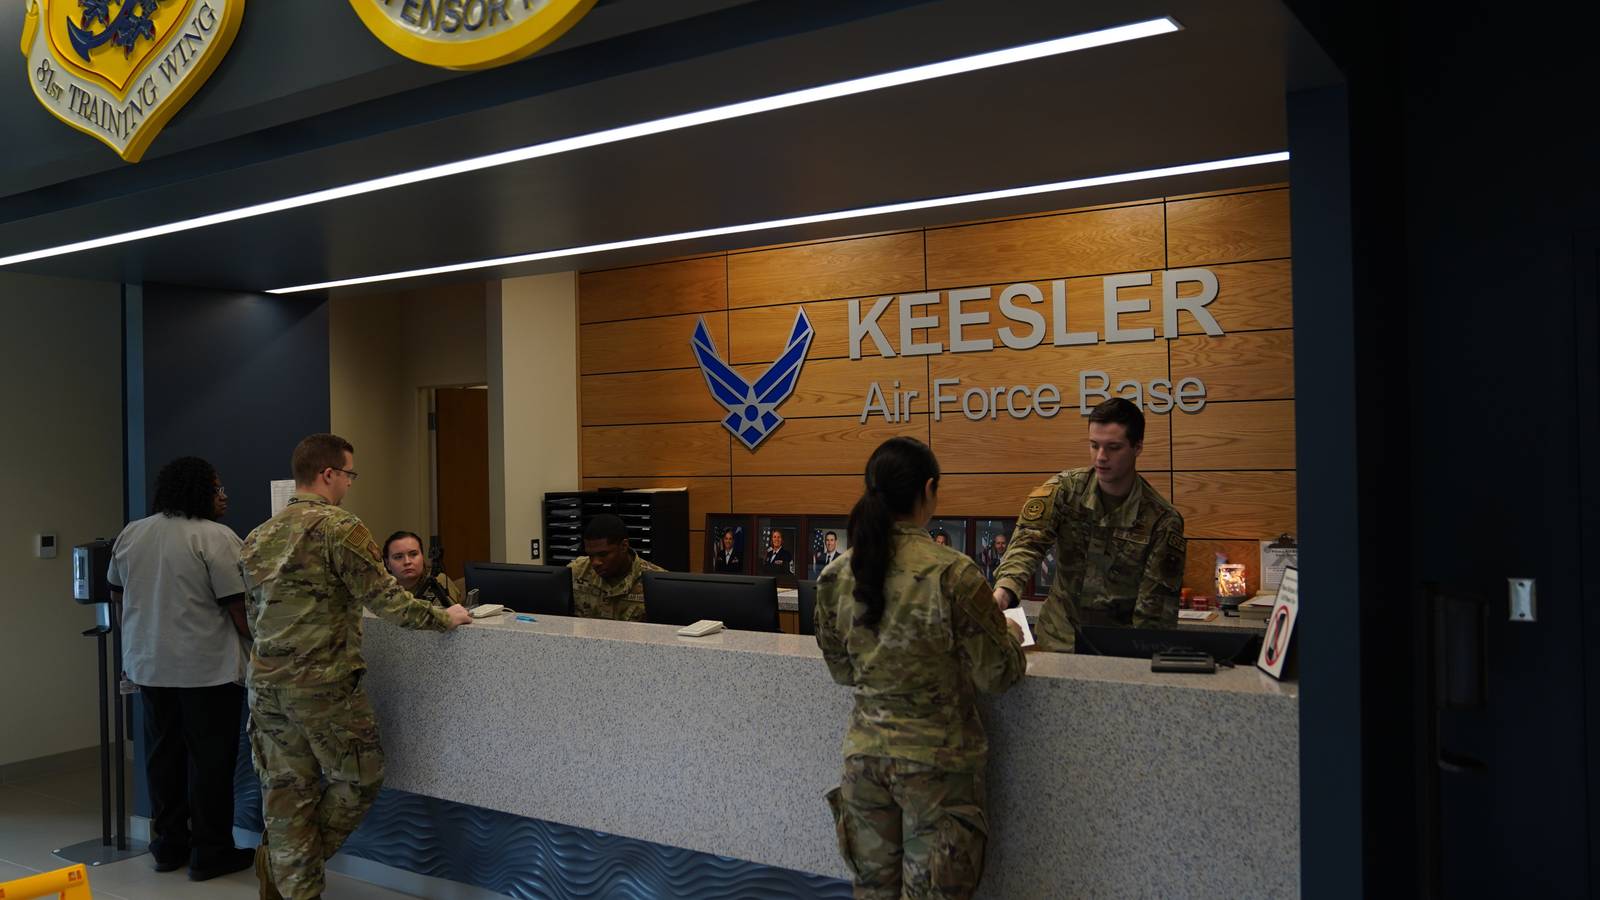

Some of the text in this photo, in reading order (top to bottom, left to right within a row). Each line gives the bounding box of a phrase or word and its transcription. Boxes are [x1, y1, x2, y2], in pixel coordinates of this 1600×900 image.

[384, 0, 514, 34] ENSOR
[68, 75, 158, 140] TRAINING
[158, 1, 218, 85] WING
[847, 267, 1225, 360] KEESLER
[859, 369, 1208, 424] Air Force Base
